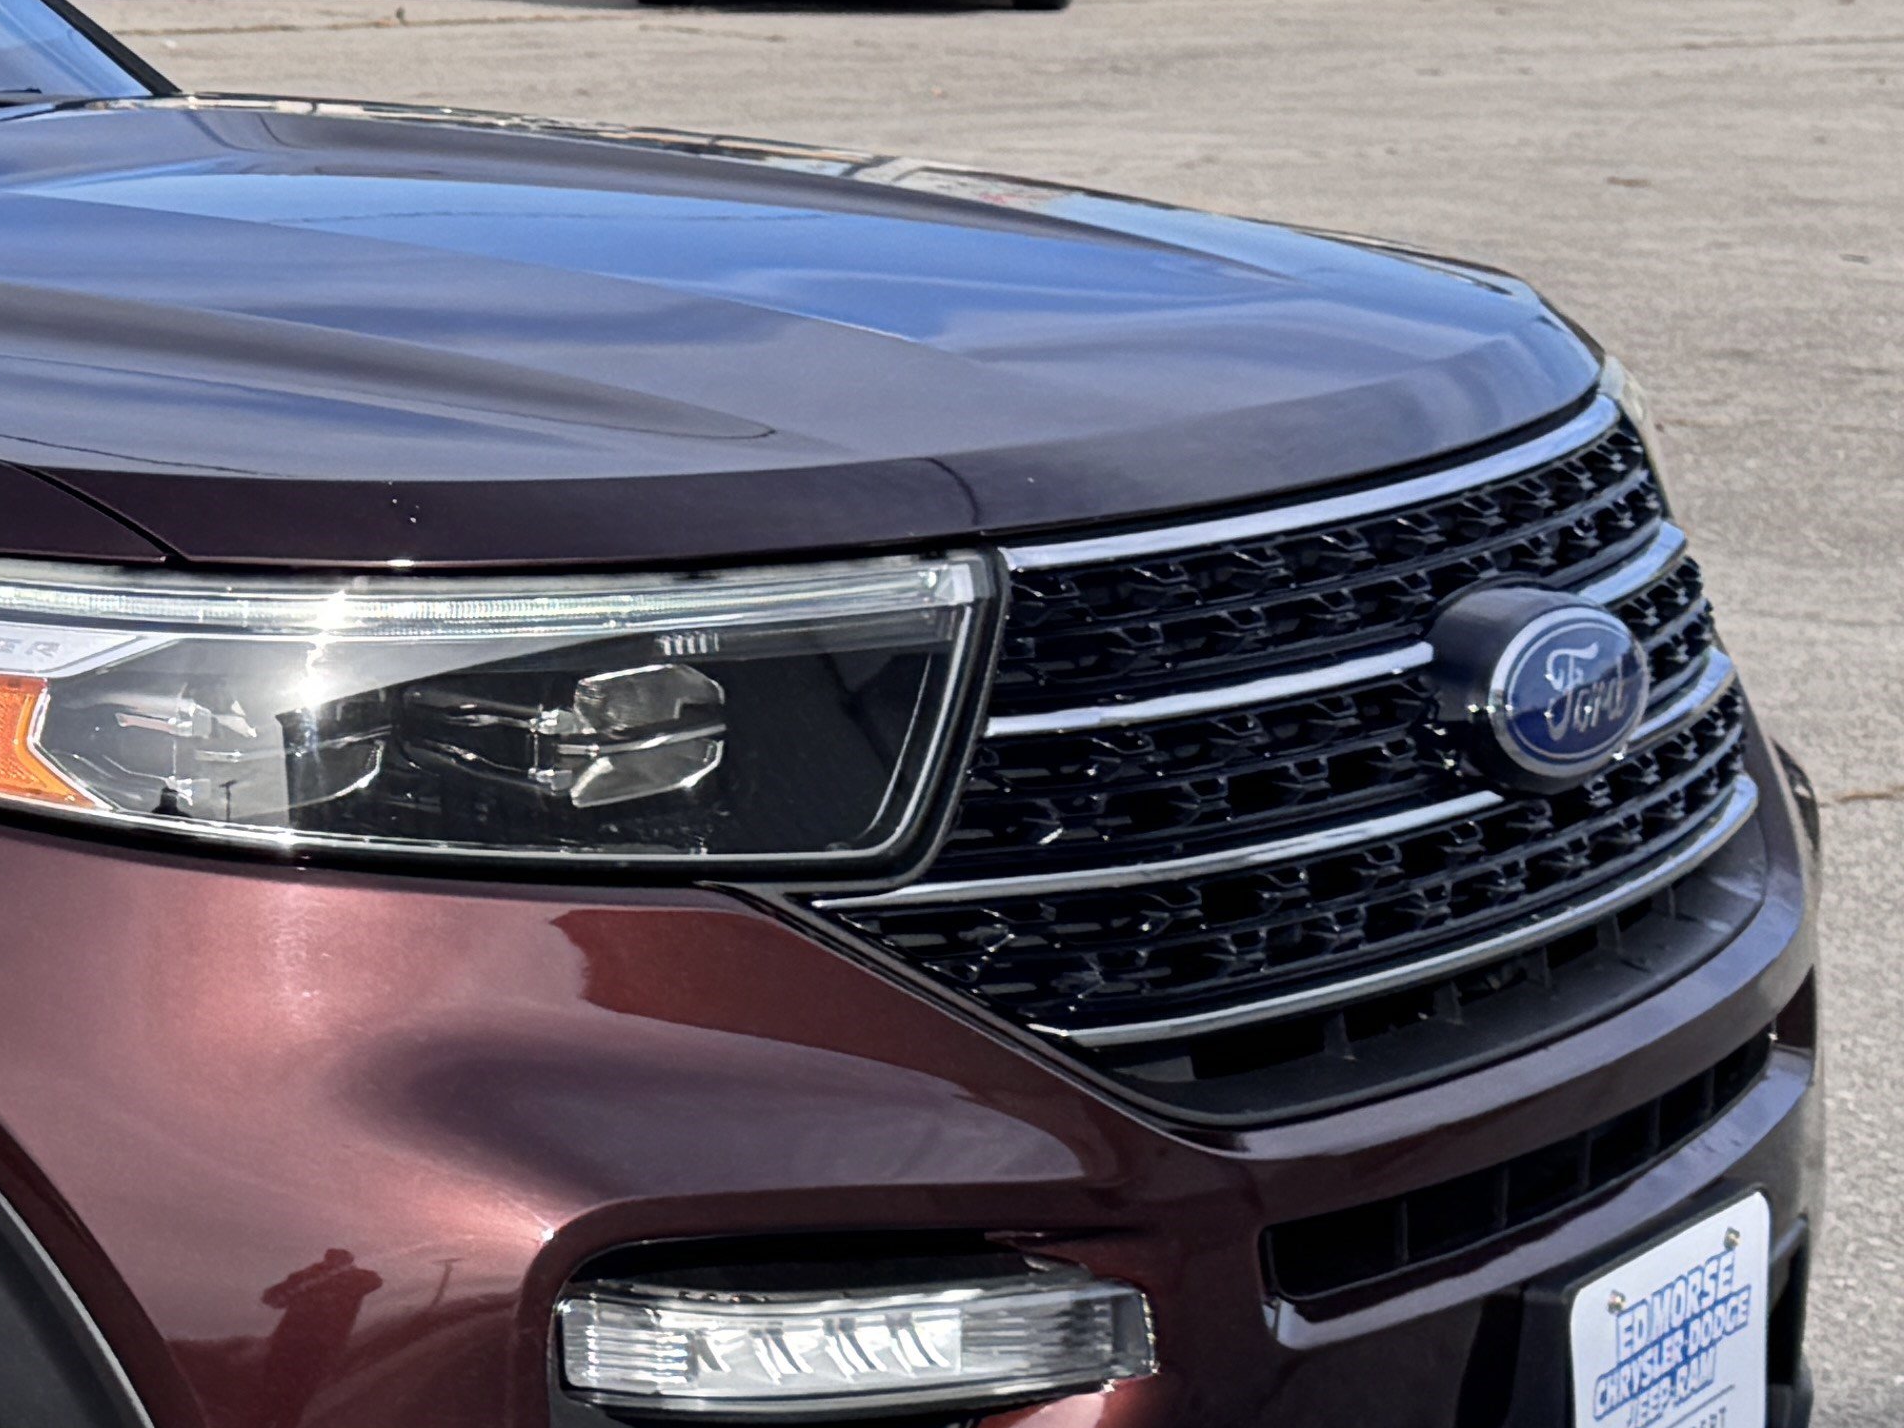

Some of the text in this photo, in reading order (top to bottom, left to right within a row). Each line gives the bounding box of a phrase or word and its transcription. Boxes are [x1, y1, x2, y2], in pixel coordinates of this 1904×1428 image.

[1544, 641, 1629, 742] Ford
[1617, 1251, 1736, 1364] ED MORSE
[1675, 1346, 1717, 1406] RAM
